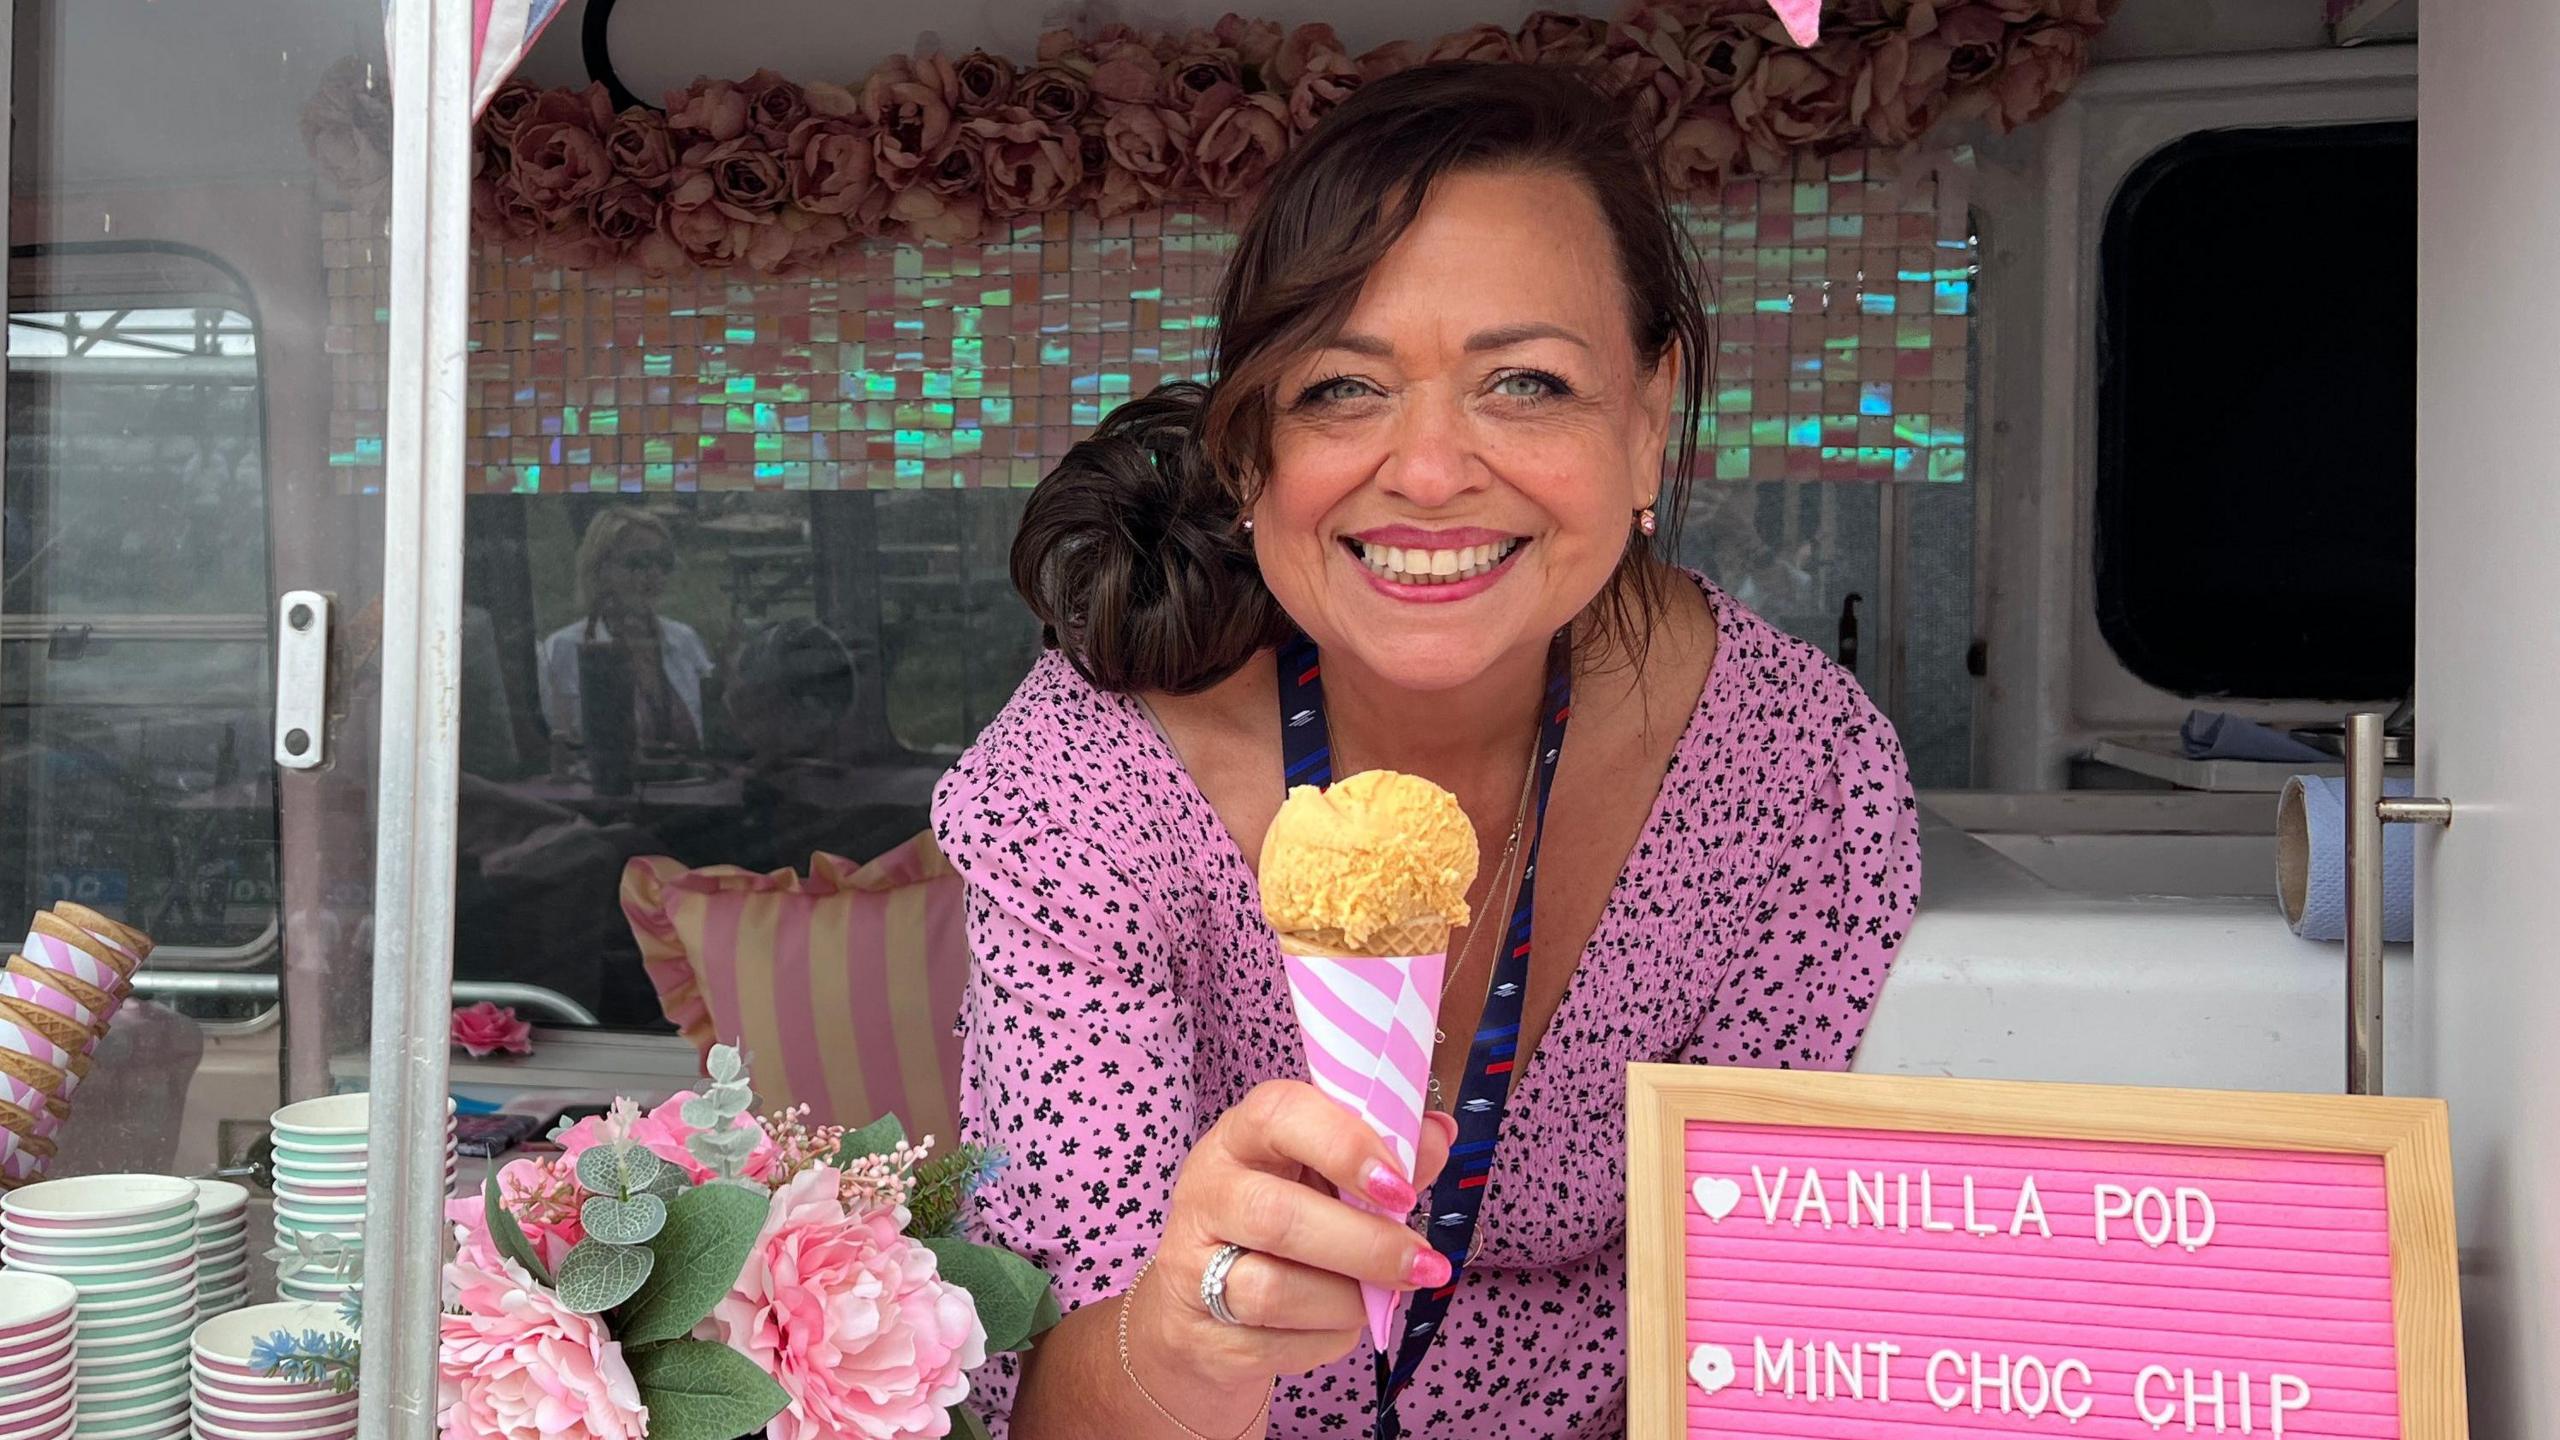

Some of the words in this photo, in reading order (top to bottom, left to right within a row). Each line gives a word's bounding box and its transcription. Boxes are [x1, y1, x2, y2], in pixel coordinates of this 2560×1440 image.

[1752, 1164, 2052, 1238] VANILLA
[2093, 1183, 2216, 1252] POD
[1925, 1348, 2093, 1424] CHOC
[2133, 1364, 2312, 1440] CHIP
